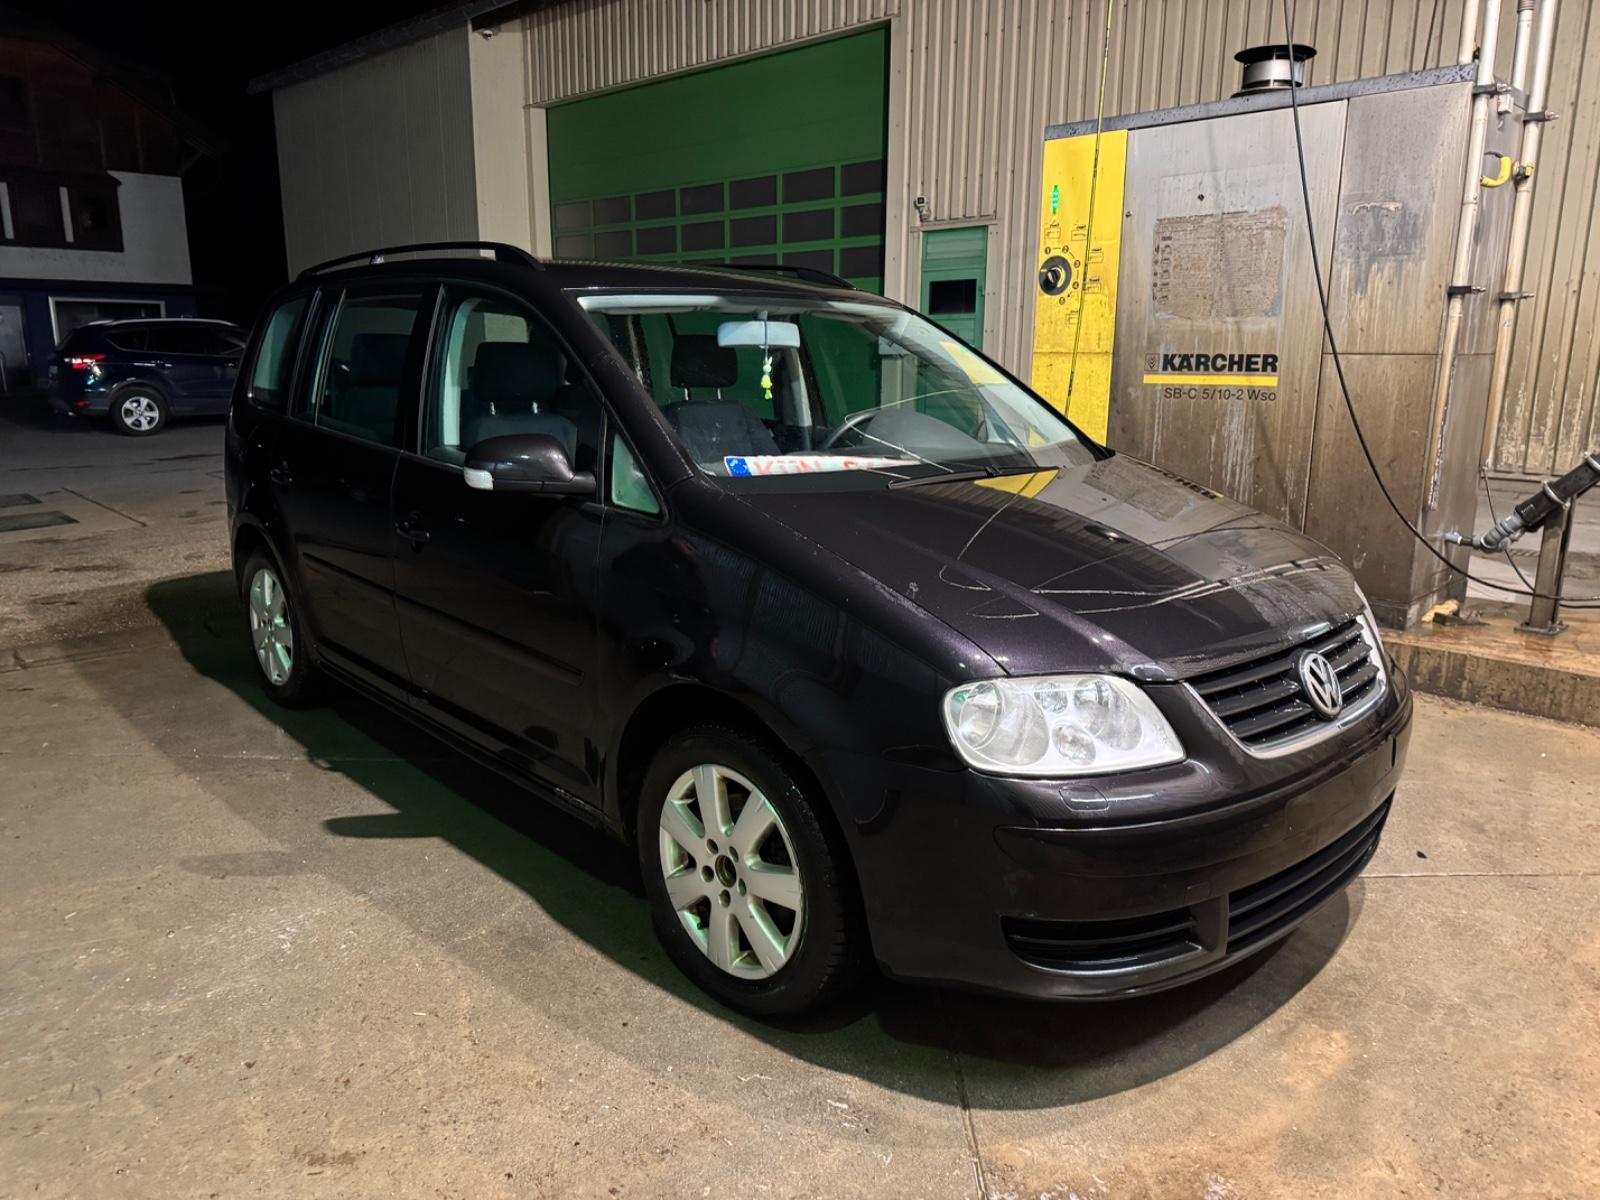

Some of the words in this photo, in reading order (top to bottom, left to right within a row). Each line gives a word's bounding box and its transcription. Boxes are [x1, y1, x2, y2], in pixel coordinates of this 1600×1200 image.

[1161, 353, 1279, 373] KÄRCHER
[1163, 387, 1198, 400] SB-C
[1201, 388, 1244, 401] 5/10-2
[1246, 389, 1277, 402] Wso
